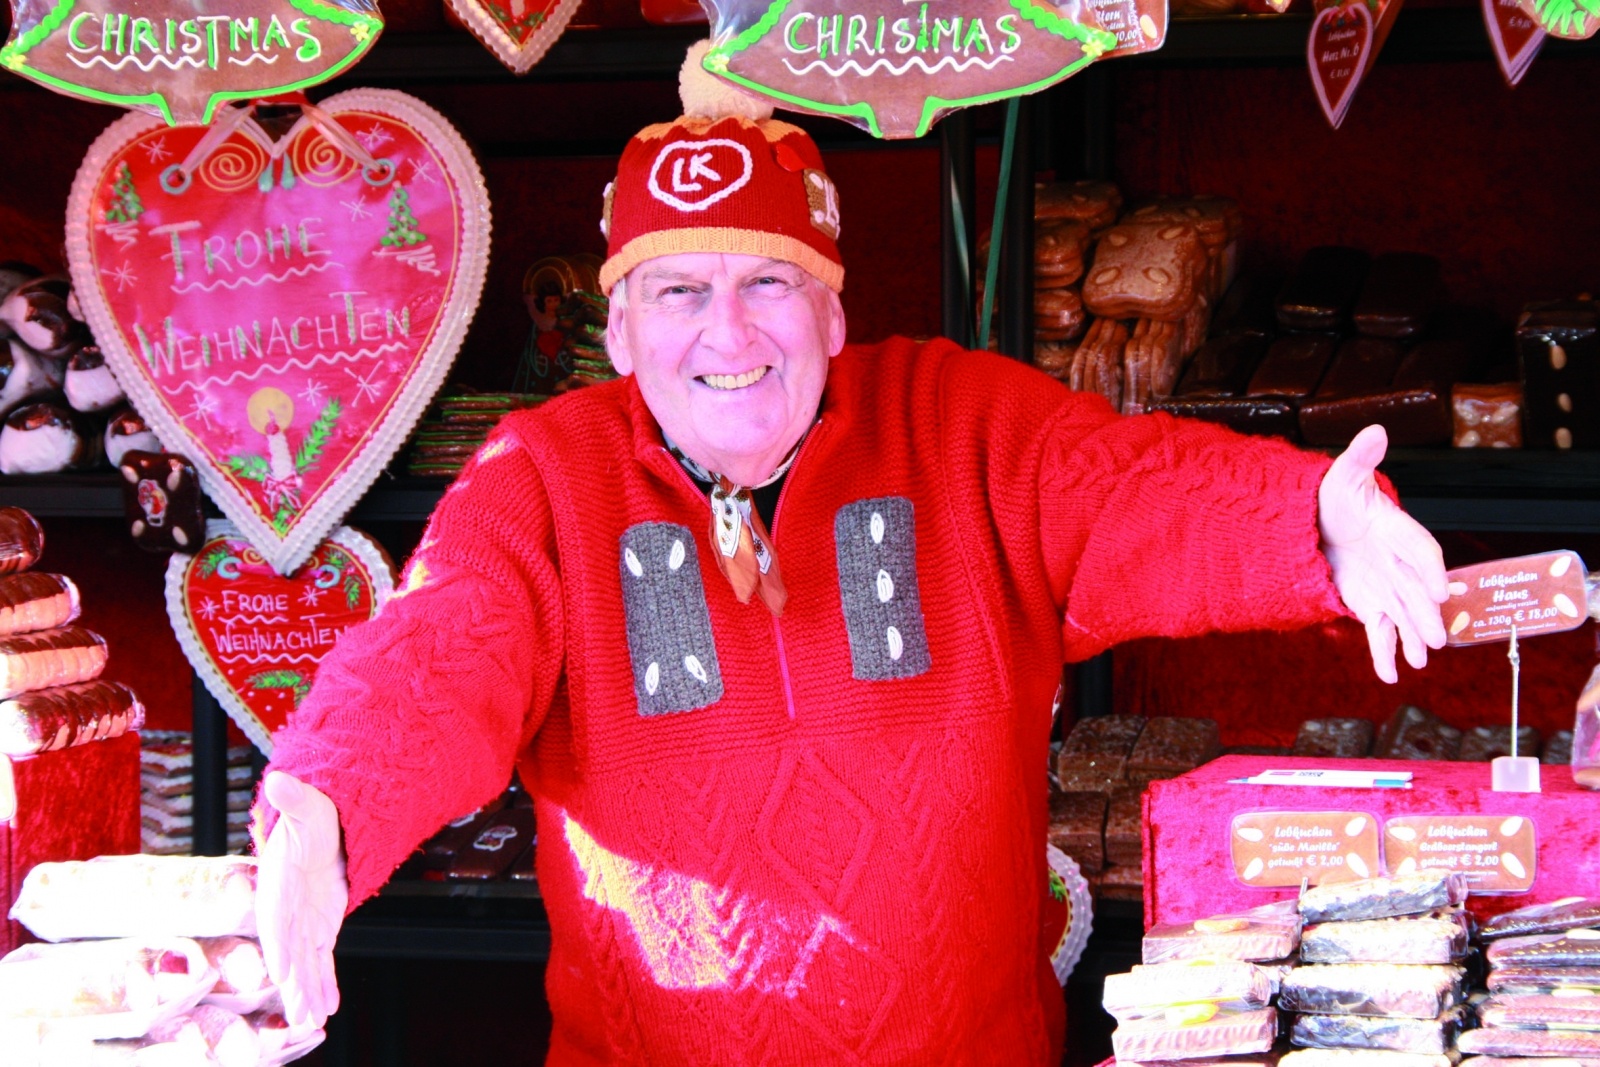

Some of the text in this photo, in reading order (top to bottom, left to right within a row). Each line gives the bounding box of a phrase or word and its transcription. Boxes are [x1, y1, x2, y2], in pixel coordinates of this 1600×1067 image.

[784, 0, 1022, 58] CHRISTMAS
[67, 12, 322, 70] CHRISTMAS
[672, 152, 721, 192] LK
[150, 217, 332, 281] FROHE
[133, 291, 412, 378] WEIHNACHTEN
[1479, 571, 1538, 588] Lebkuchen
[221, 590, 289, 613] FROHE
[1493, 589, 1529, 602] Haus
[1473, 607, 1558, 628] ca. 130g € 18,00
[1274, 826, 1333, 839] Lebkuchen
[1427, 825, 1488, 839] Lebkuchen
[1268, 854, 1343, 869] getunkt € 2,00
[1420, 854, 1499, 869] getunkt € 2,00
